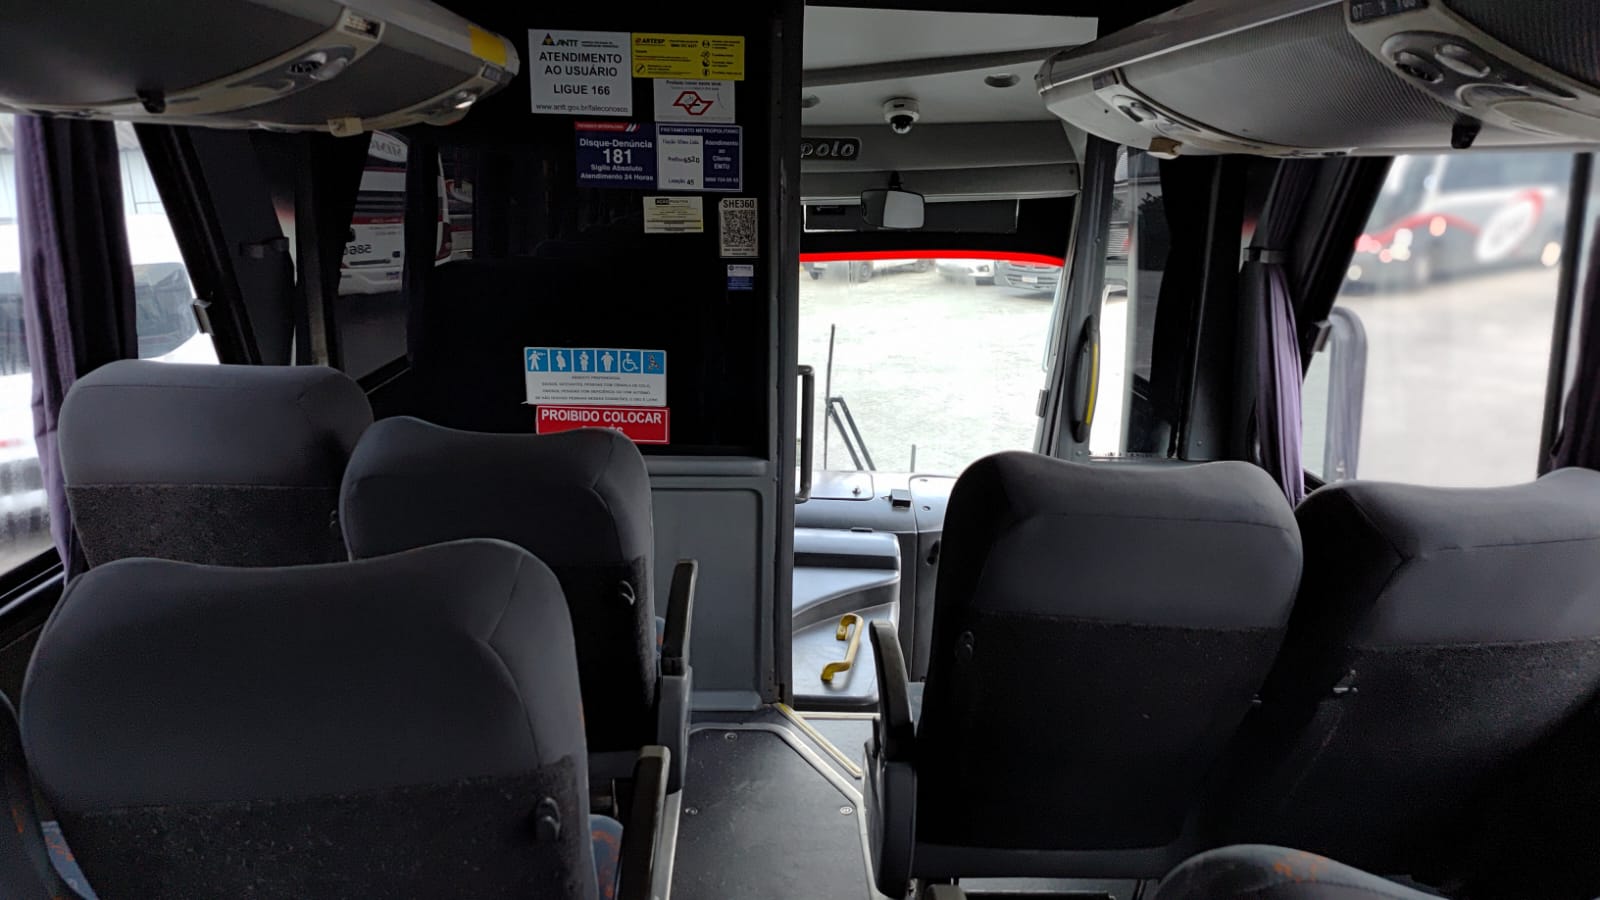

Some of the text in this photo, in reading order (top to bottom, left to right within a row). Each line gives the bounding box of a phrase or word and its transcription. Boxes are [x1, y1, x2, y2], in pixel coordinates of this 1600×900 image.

[556, 39, 578, 47] ANTT
[539, 52, 622, 63] ATENDIMENTO
[545, 64, 618, 77] AO USUÁRIO
[553, 84, 610, 95] LIGUE 166
[579, 138, 653, 149] Disque-Denúncia
[602, 148, 632, 164] 181
[590, 164, 643, 172] Sigilo Absoluto
[580, 172, 623, 180] Atendimento
[723, 199, 755, 209] SHE360
[541, 409, 661, 424] PROIBIDO COLOCAR
